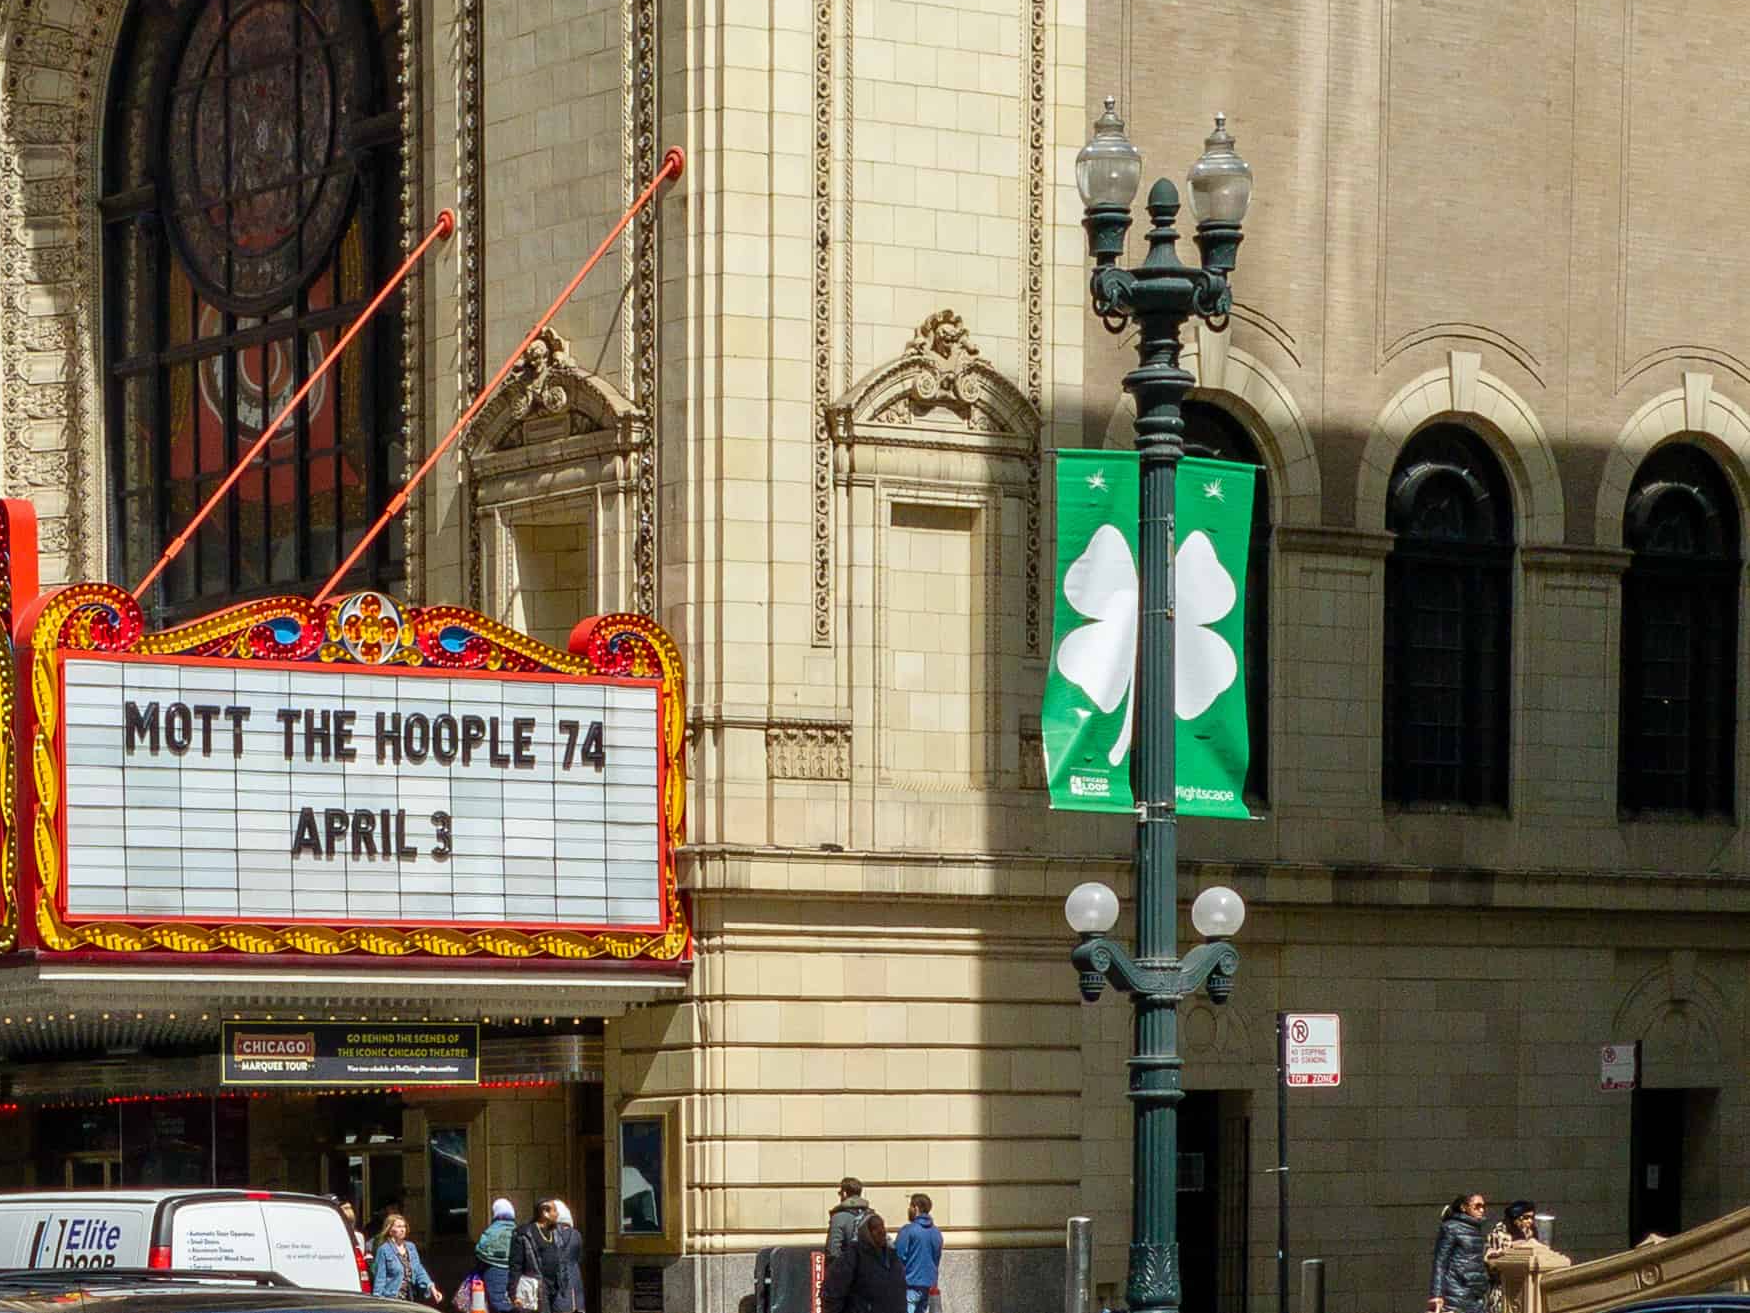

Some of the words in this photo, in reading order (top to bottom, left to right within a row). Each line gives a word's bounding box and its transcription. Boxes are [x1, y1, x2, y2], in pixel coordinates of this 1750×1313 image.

[124, 701, 251, 758] MOTT
[276, 707, 357, 763] THE
[376, 712, 537, 769] HOOPLE
[558, 719, 606, 772] 74
[1082, 783, 1109, 791] LOOP
[291, 806, 417, 862] APRIL
[430, 809, 453, 862] 3
[346, 1033, 360, 1043] GO
[362, 1033, 395, 1043] BEHIND
[396, 1033, 413, 1043] THE
[414, 1033, 446, 1043] SCENES
[243, 1040, 306, 1053] CHICAGO
[338, 1047, 354, 1057] THE
[356, 1047, 386, 1057] ICONIC
[388, 1047, 428, 1057] CHICAGO
[241, 1061, 284, 1072] MARQUEE
[285, 1061, 308, 1072] TOUR
[1291, 1074, 1309, 1084] TOW
[65, 1219, 121, 1250] Elite
